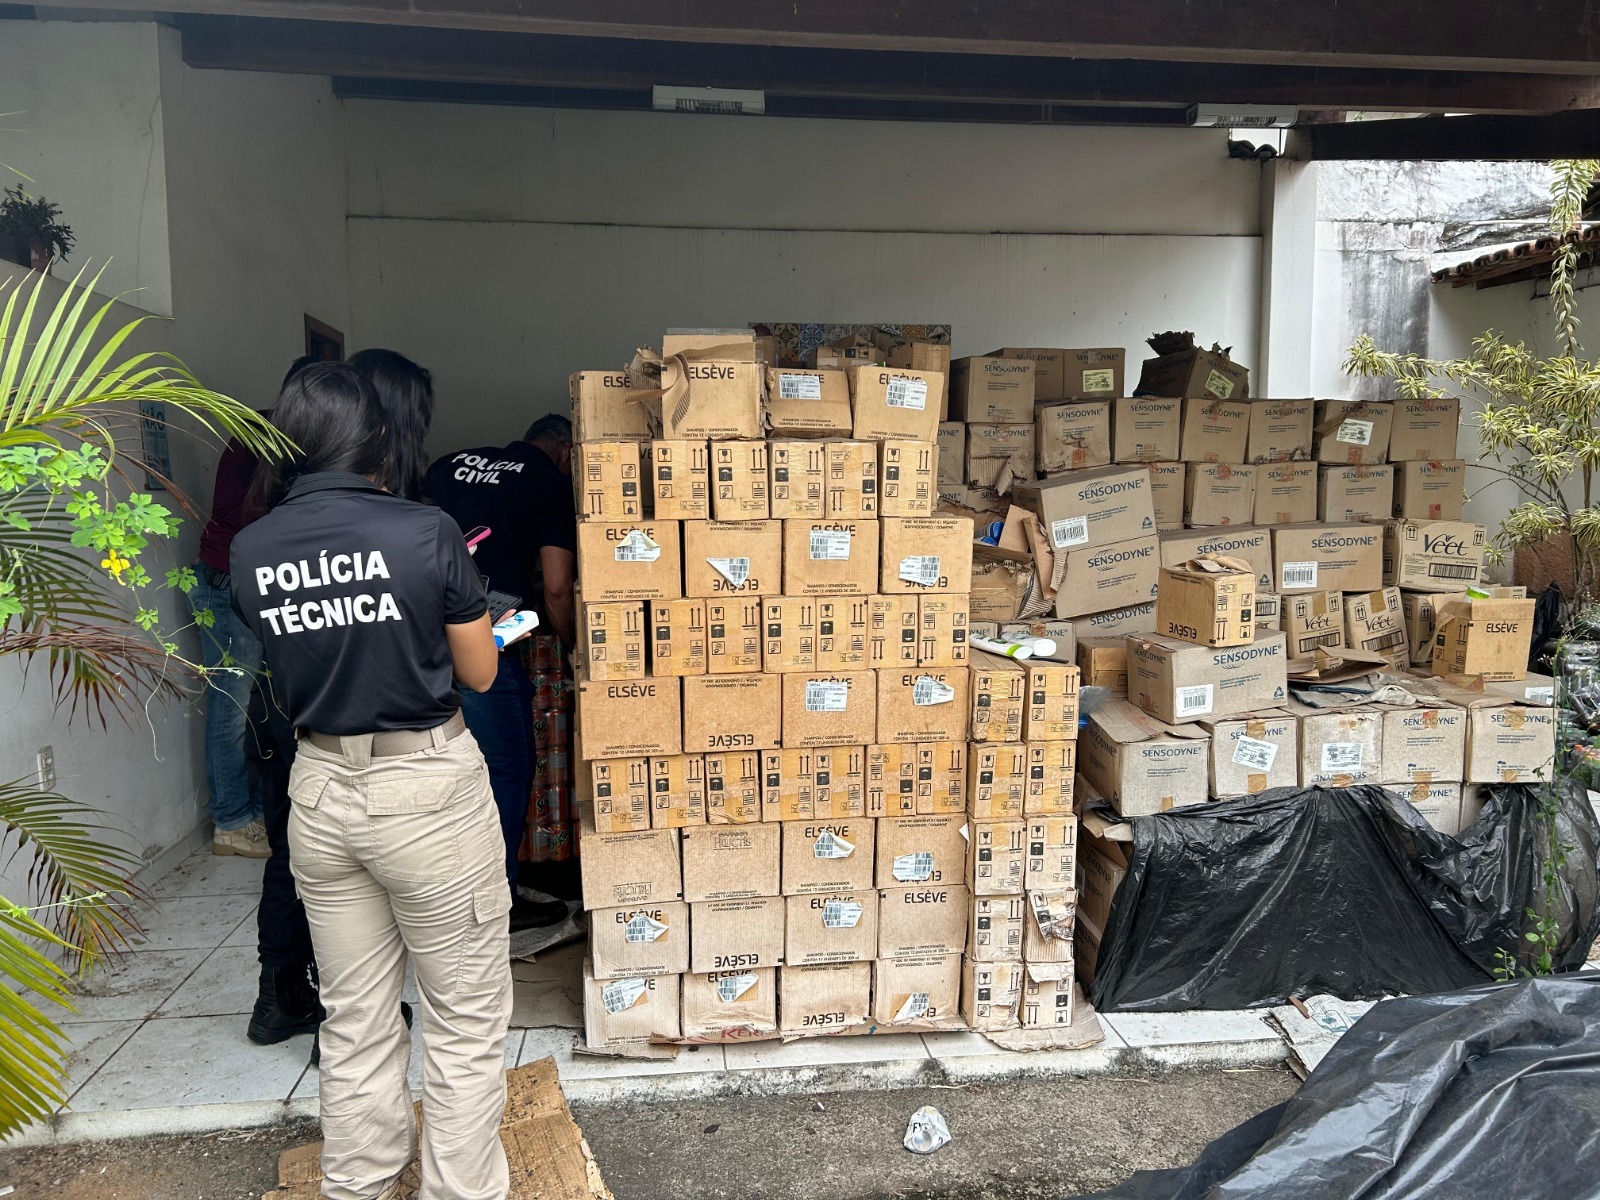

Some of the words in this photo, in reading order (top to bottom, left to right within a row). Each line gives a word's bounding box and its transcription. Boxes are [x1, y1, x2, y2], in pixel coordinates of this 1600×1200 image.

[689, 364, 735, 380] ELSÈVE
[603, 374, 631, 388] ELSÈ
[1057, 409, 1101, 420] SENSODYNE
[451, 453, 525, 474] POLÍCIA
[454, 466, 500, 484] CIVIL
[1078, 478, 1142, 501] SENSODYNE
[1197, 537, 1260, 555] SENSODYNE
[1311, 537, 1374, 548] SENSODYNE
[1424, 533, 1470, 556] Veet
[1087, 548, 1151, 568] SENSODYNE
[255, 550, 390, 596] POLÍCIA
[260, 592, 402, 636] TÉCNICA
[1089, 605, 1151, 626] SENSODYNE
[1304, 614, 1333, 630] Veet
[1169, 622, 1197, 640] ELSÈVE
[1366, 614, 1394, 632] Veet
[1486, 621, 1518, 633] ELSÈVE
[1213, 645, 1278, 666] SENSODYNE
[608, 682, 656, 698] ELSÈVE
[708, 734, 754, 749] ELSÈVE
[1142, 747, 1198, 758] SENSODYNE
[904, 890, 947, 904] ELSÈVE
[715, 953, 759, 970] ELSÈVE
[803, 1012, 845, 1027] ELSÈVE
